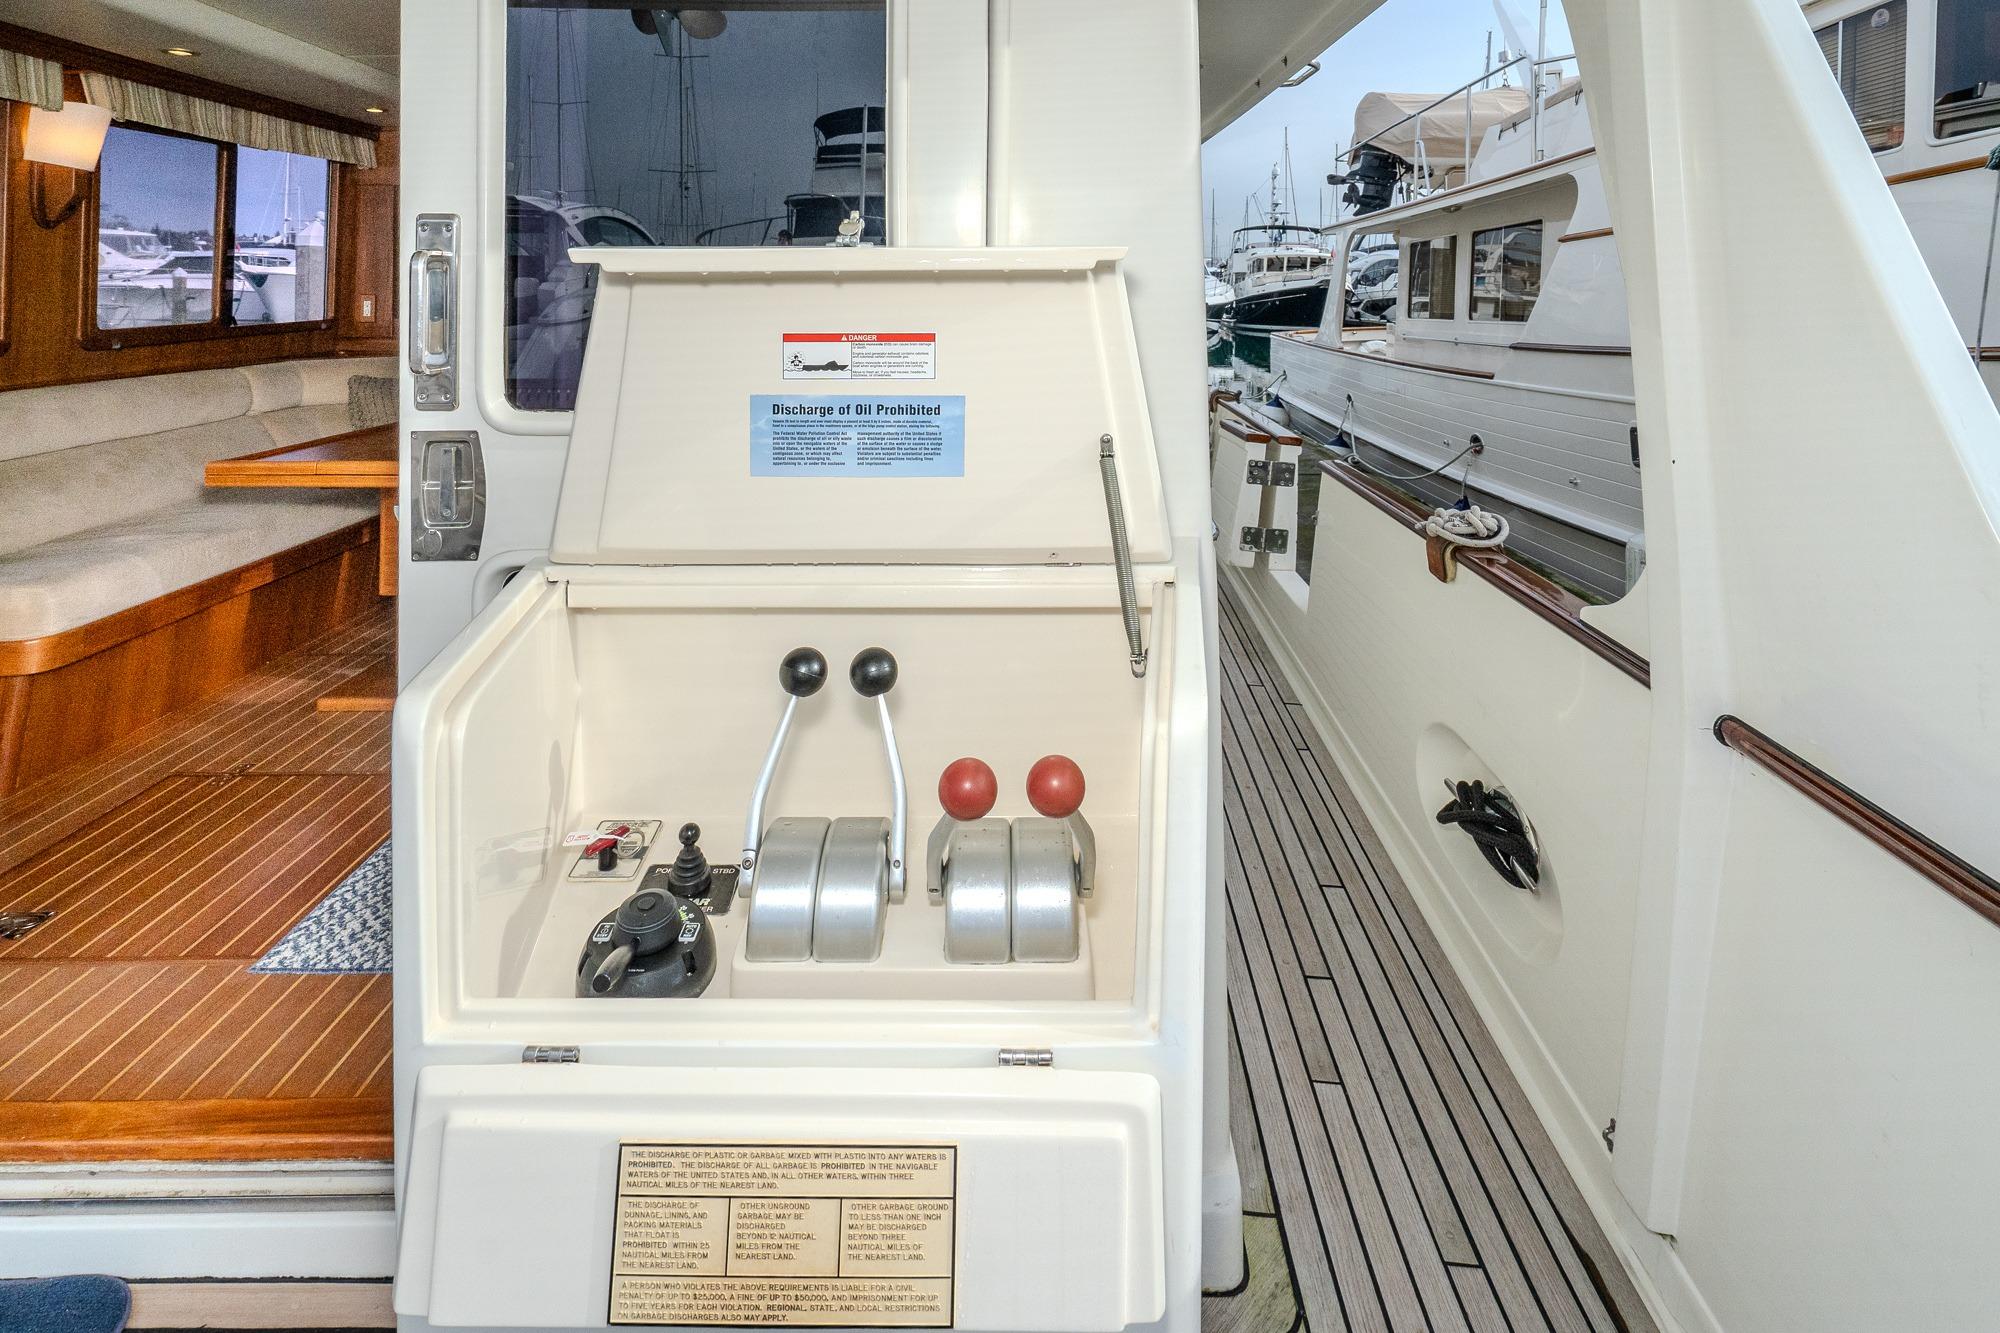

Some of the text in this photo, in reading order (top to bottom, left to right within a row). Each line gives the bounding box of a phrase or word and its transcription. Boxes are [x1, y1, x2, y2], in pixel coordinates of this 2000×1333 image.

[772, 404, 940, 417] Discharge of Oil Prohibited
